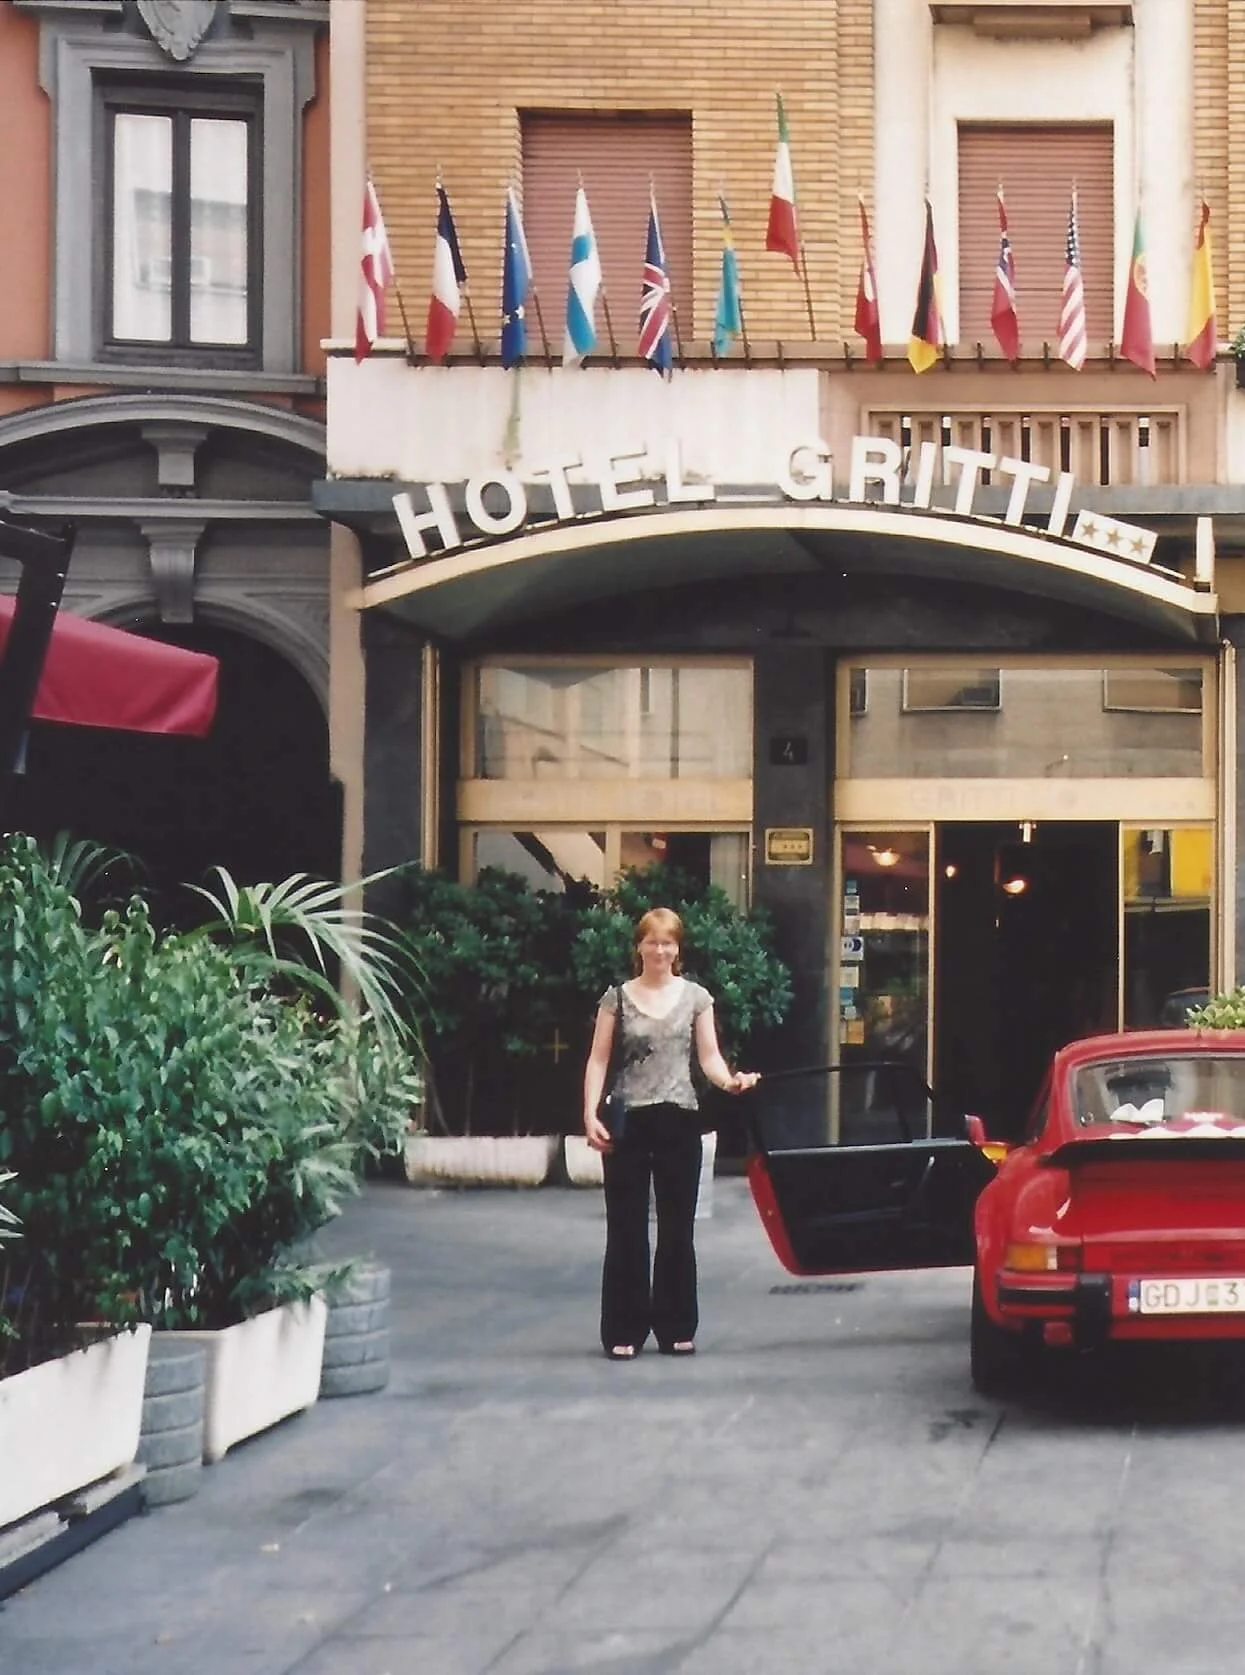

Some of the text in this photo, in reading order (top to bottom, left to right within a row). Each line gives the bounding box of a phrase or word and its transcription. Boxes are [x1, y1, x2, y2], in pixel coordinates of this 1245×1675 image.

[392, 435, 1074, 559] HOTEL GRITTI
[1144, 1283, 1200, 1308] GDJ
